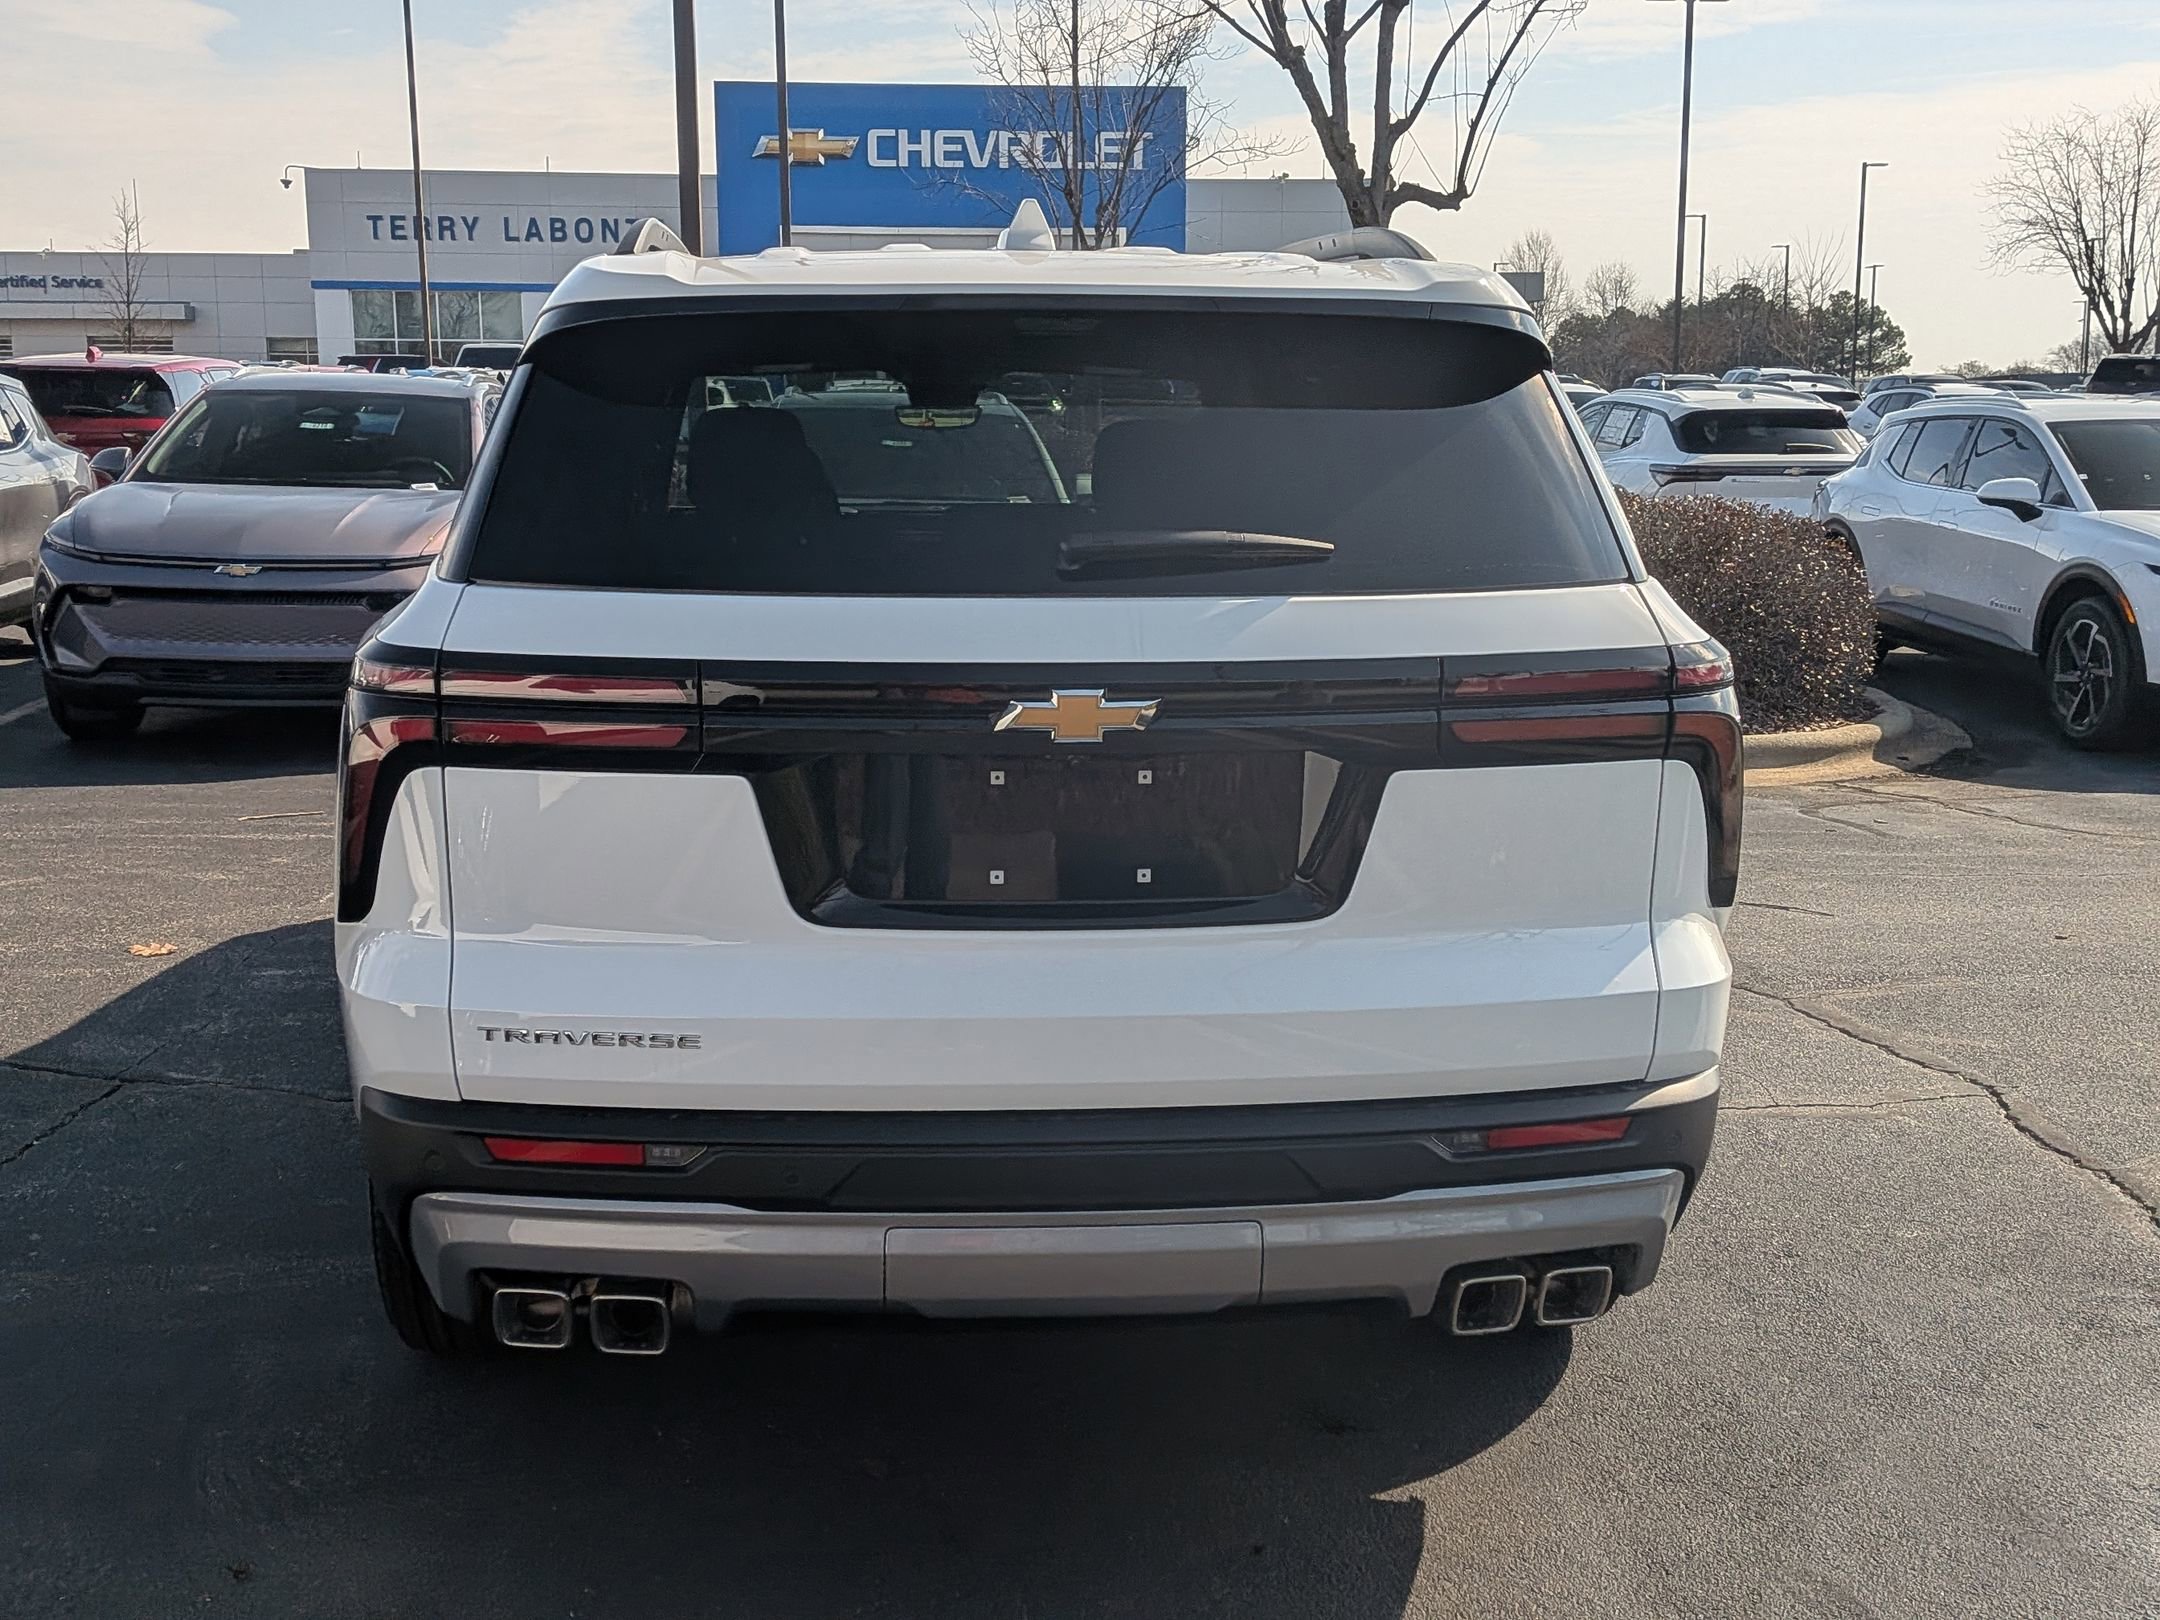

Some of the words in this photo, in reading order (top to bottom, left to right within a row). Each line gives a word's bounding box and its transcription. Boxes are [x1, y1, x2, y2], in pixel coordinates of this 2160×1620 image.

[867, 128, 1154, 169] CHEVROLET
[366, 214, 479, 241] TERRY
[51, 274, 104, 288] Service
[477, 1026, 702, 1049] TRAVERSE
